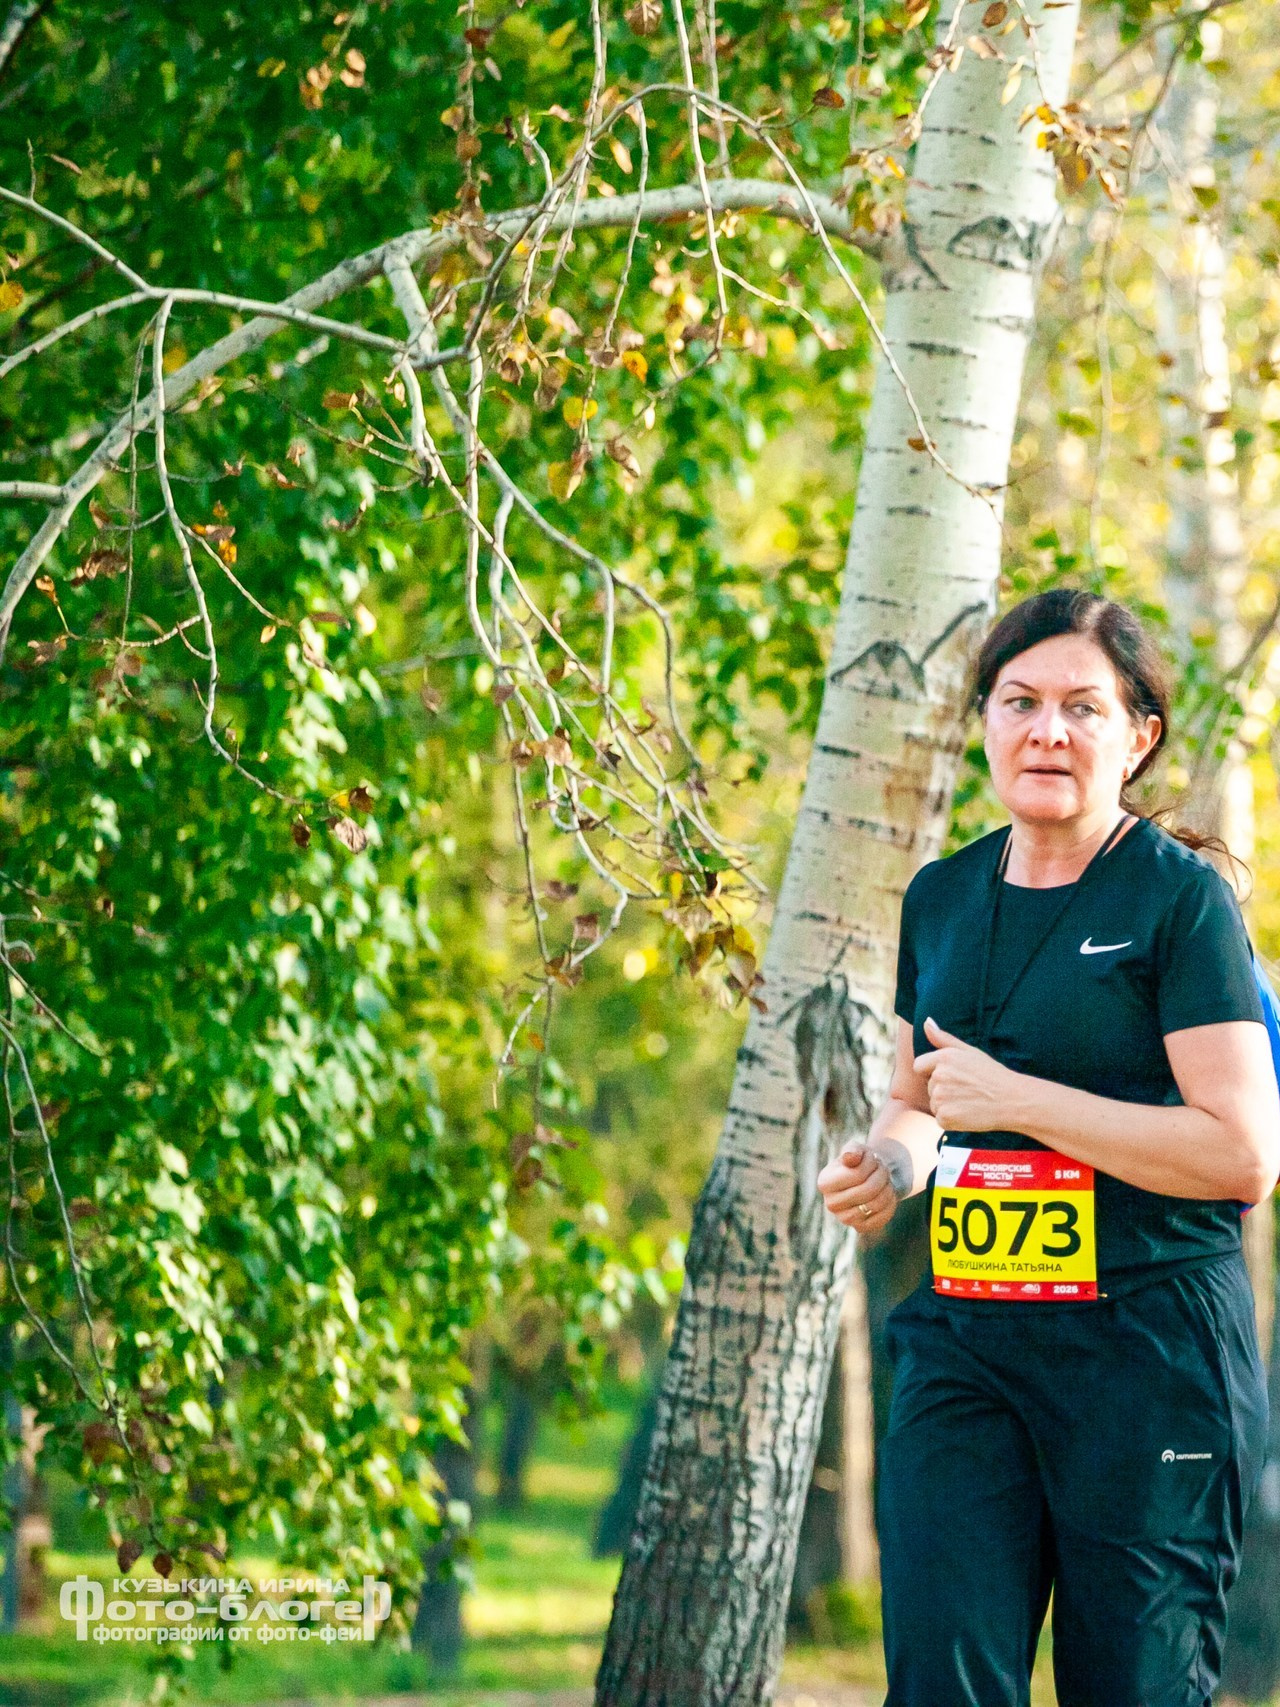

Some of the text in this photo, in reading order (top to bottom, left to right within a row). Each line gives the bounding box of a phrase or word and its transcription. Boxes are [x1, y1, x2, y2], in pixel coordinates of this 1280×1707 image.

[969, 1162, 1032, 1173] КРАСНОЯРСКИЕ
[983, 1172, 1014, 1181] МОСТЫ
[938, 1197, 1081, 1257] 5073
[948, 1259, 1063, 1273] ЛЮБУШКИНА ТАТЬЯНА
